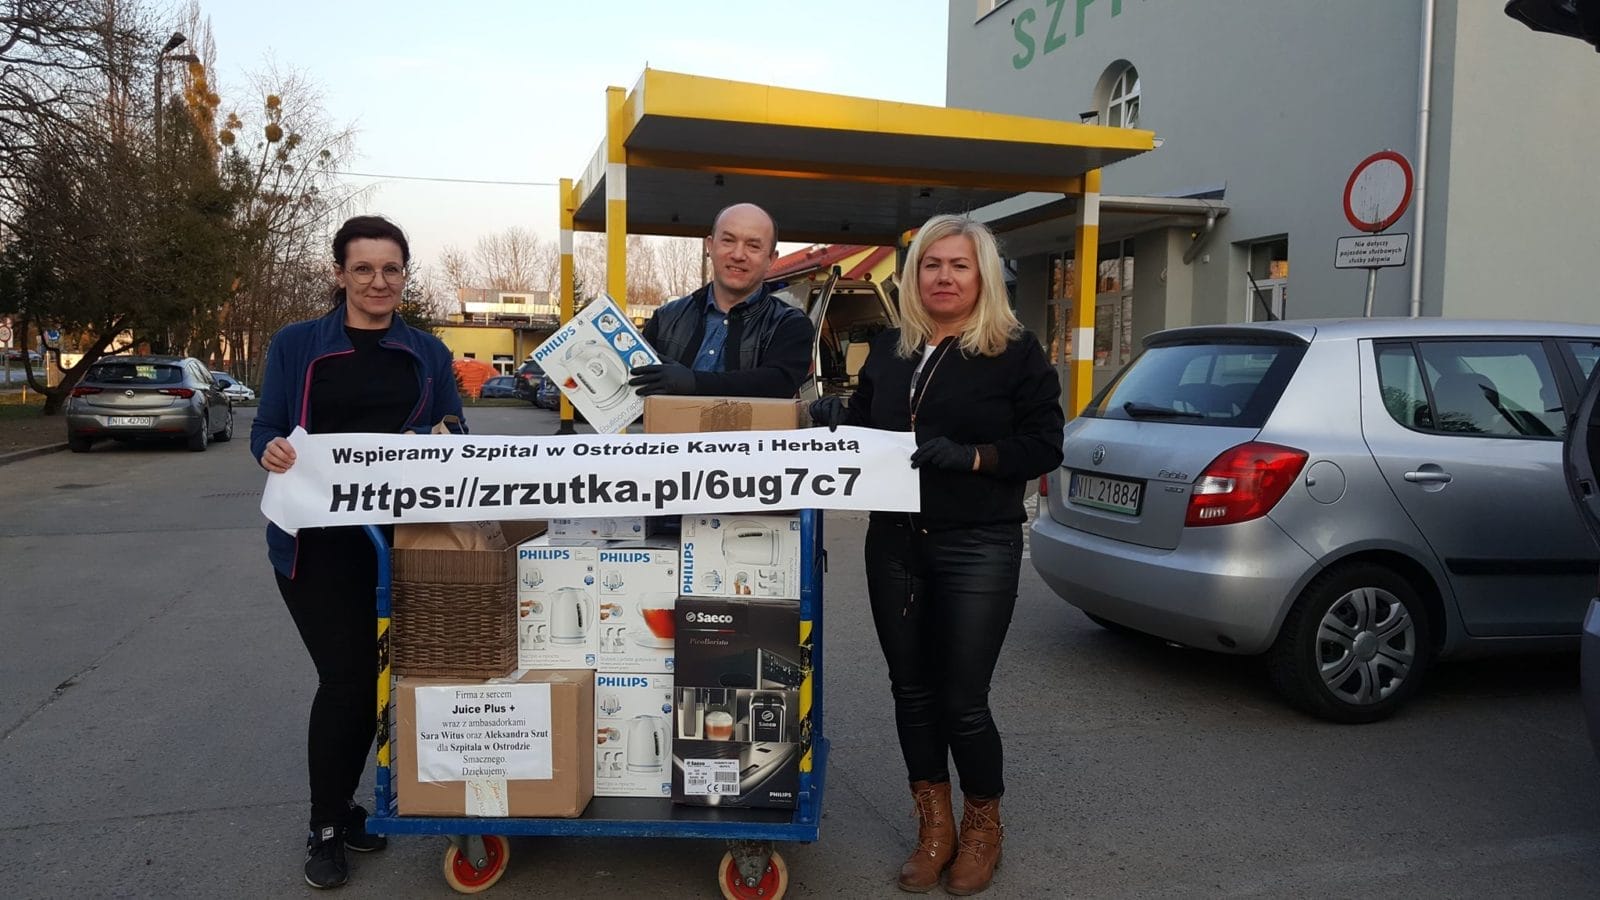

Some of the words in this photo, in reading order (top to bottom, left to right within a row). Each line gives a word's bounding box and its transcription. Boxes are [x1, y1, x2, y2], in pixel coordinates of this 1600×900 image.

[1012, 0, 1122, 70] SZP
[534, 325, 577, 362] PHILIPS
[332, 447, 453, 466] Wspieramy
[462, 444, 538, 461] Szpital
[547, 447, 565, 456] w
[573, 442, 679, 456] Ostródzie
[688, 442, 750, 455] Kawą
[759, 440, 763, 451] i
[772, 439, 860, 453] Herbatą
[329, 467, 862, 517] Https://zrzutka.pl/6ug7c7
[1076, 477, 1094, 500] NIL
[1099, 479, 1139, 506] 21884
[519, 549, 570, 560] PHILIPS
[600, 552, 650, 563] PHILIPS
[683, 542, 694, 593] PHILIPS
[697, 612, 733, 623] Saeco
[597, 676, 648, 688] PHILIPS
[455, 690, 479, 700] Firma
[479, 691, 485, 699] z
[485, 691, 512, 699] sercem
[451, 704, 481, 715] Juice
[484, 703, 507, 714] Plus
[461, 720, 467, 728] z
[468, 717, 526, 728] ambasadorkami
[420, 731, 439, 740] Sara
[440, 731, 465, 740] Witus
[465, 732, 483, 740] oraz
[484, 729, 529, 739] Aleksandra
[530, 729, 549, 738] Szut
[436, 743, 449, 752] dla
[450, 742, 482, 754] Szpitala
[462, 754, 507, 766] Smacznego.
[461, 766, 509, 778] Dziękujemy.
